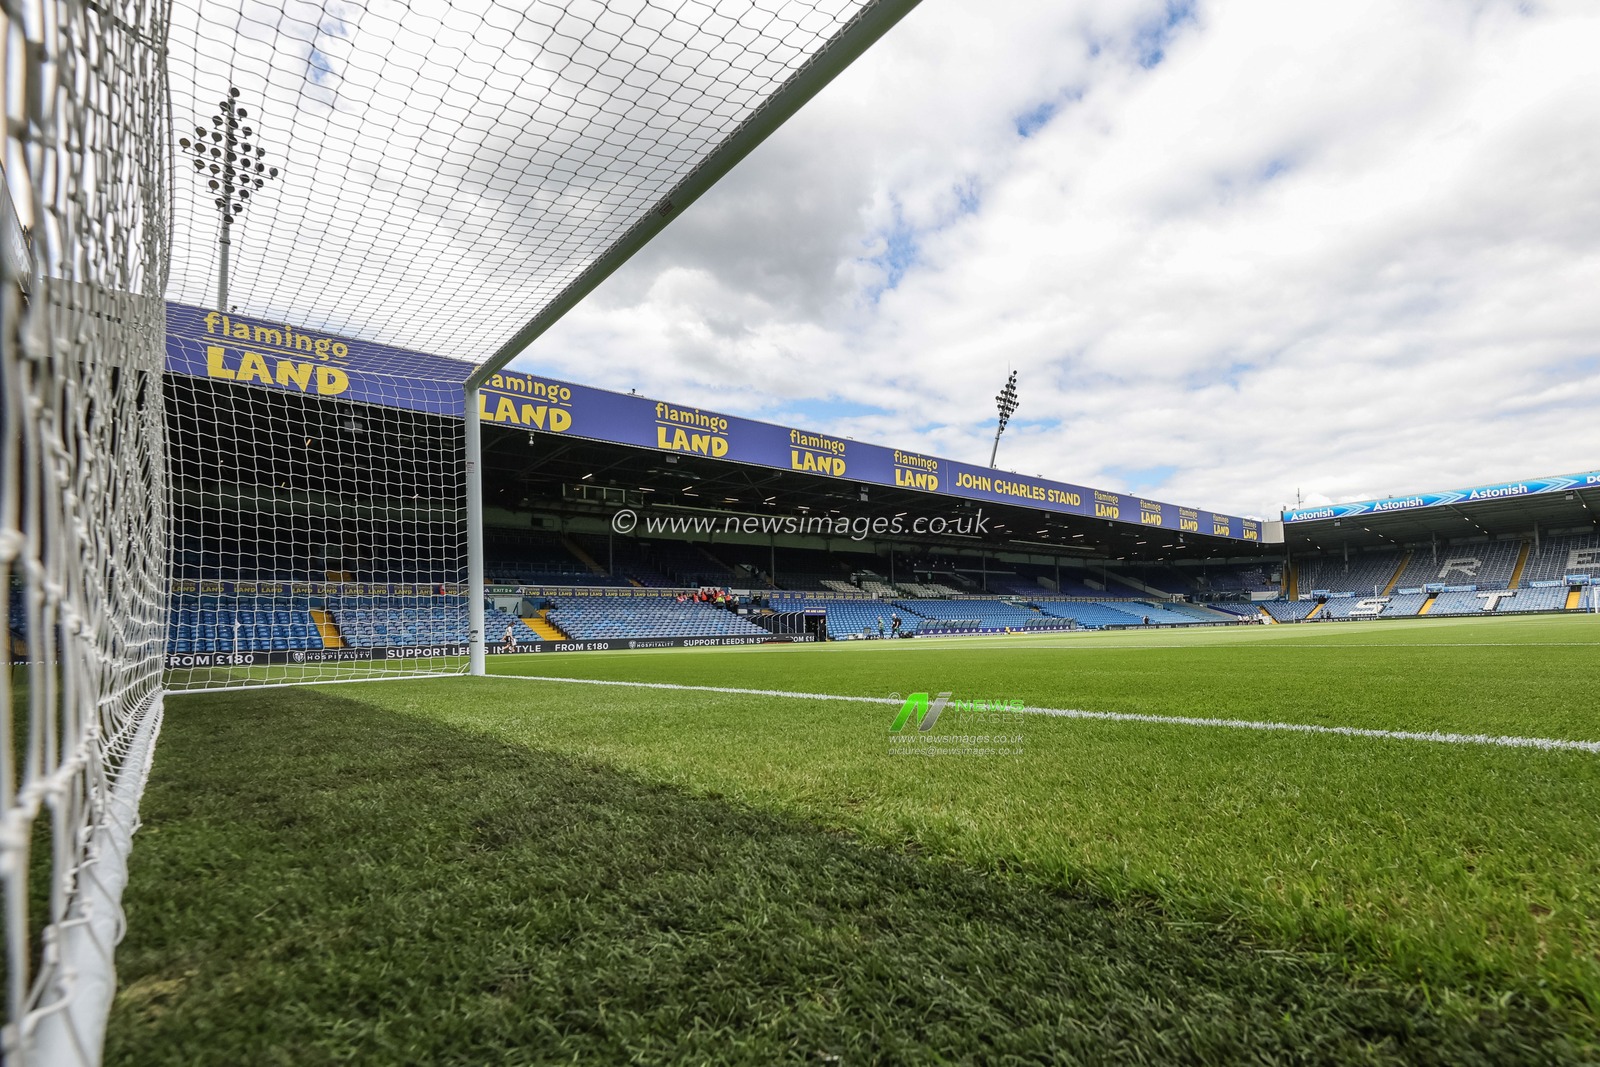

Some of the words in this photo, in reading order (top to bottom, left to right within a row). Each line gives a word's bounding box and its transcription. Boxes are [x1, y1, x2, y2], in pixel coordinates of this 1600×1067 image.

[203, 311, 348, 361] flamingo
[207, 346, 349, 395] LAND
[477, 369, 571, 403] amingo
[479, 394, 572, 432] LAND
[655, 402, 728, 433] flamingo
[657, 426, 729, 457] LAND
[789, 429, 845, 455] flamingo
[791, 450, 846, 477] LAND
[893, 449, 938, 472] flamingo
[895, 469, 939, 491] LAND
[1586, 475, 1600, 484] D
[955, 472, 992, 492] JOHN
[994, 479, 1046, 501] CHARLES
[1047, 489, 1081, 506] STAND
[1094, 490, 1119, 504] flamingo
[1469, 483, 1528, 499] Astonish
[1095, 503, 1119, 519] LAND
[1140, 499, 1161, 513] flamingo
[1373, 497, 1424, 512] Astonish
[1141, 511, 1162, 526] LAND
[1290, 508, 1334, 521] Astonish
[1180, 519, 1198, 532] LAND
[555, 643, 584, 652] FROM
[586, 642, 609, 651] £180
[683, 638, 720, 647] SUPPORT
[721, 637, 745, 645] LEEDS
[164, 654, 210, 667] FROM
[216, 654, 254, 666] £180
[307, 653, 370, 661] HOSPITALITY
[387, 647, 448, 659] SUPPORT
